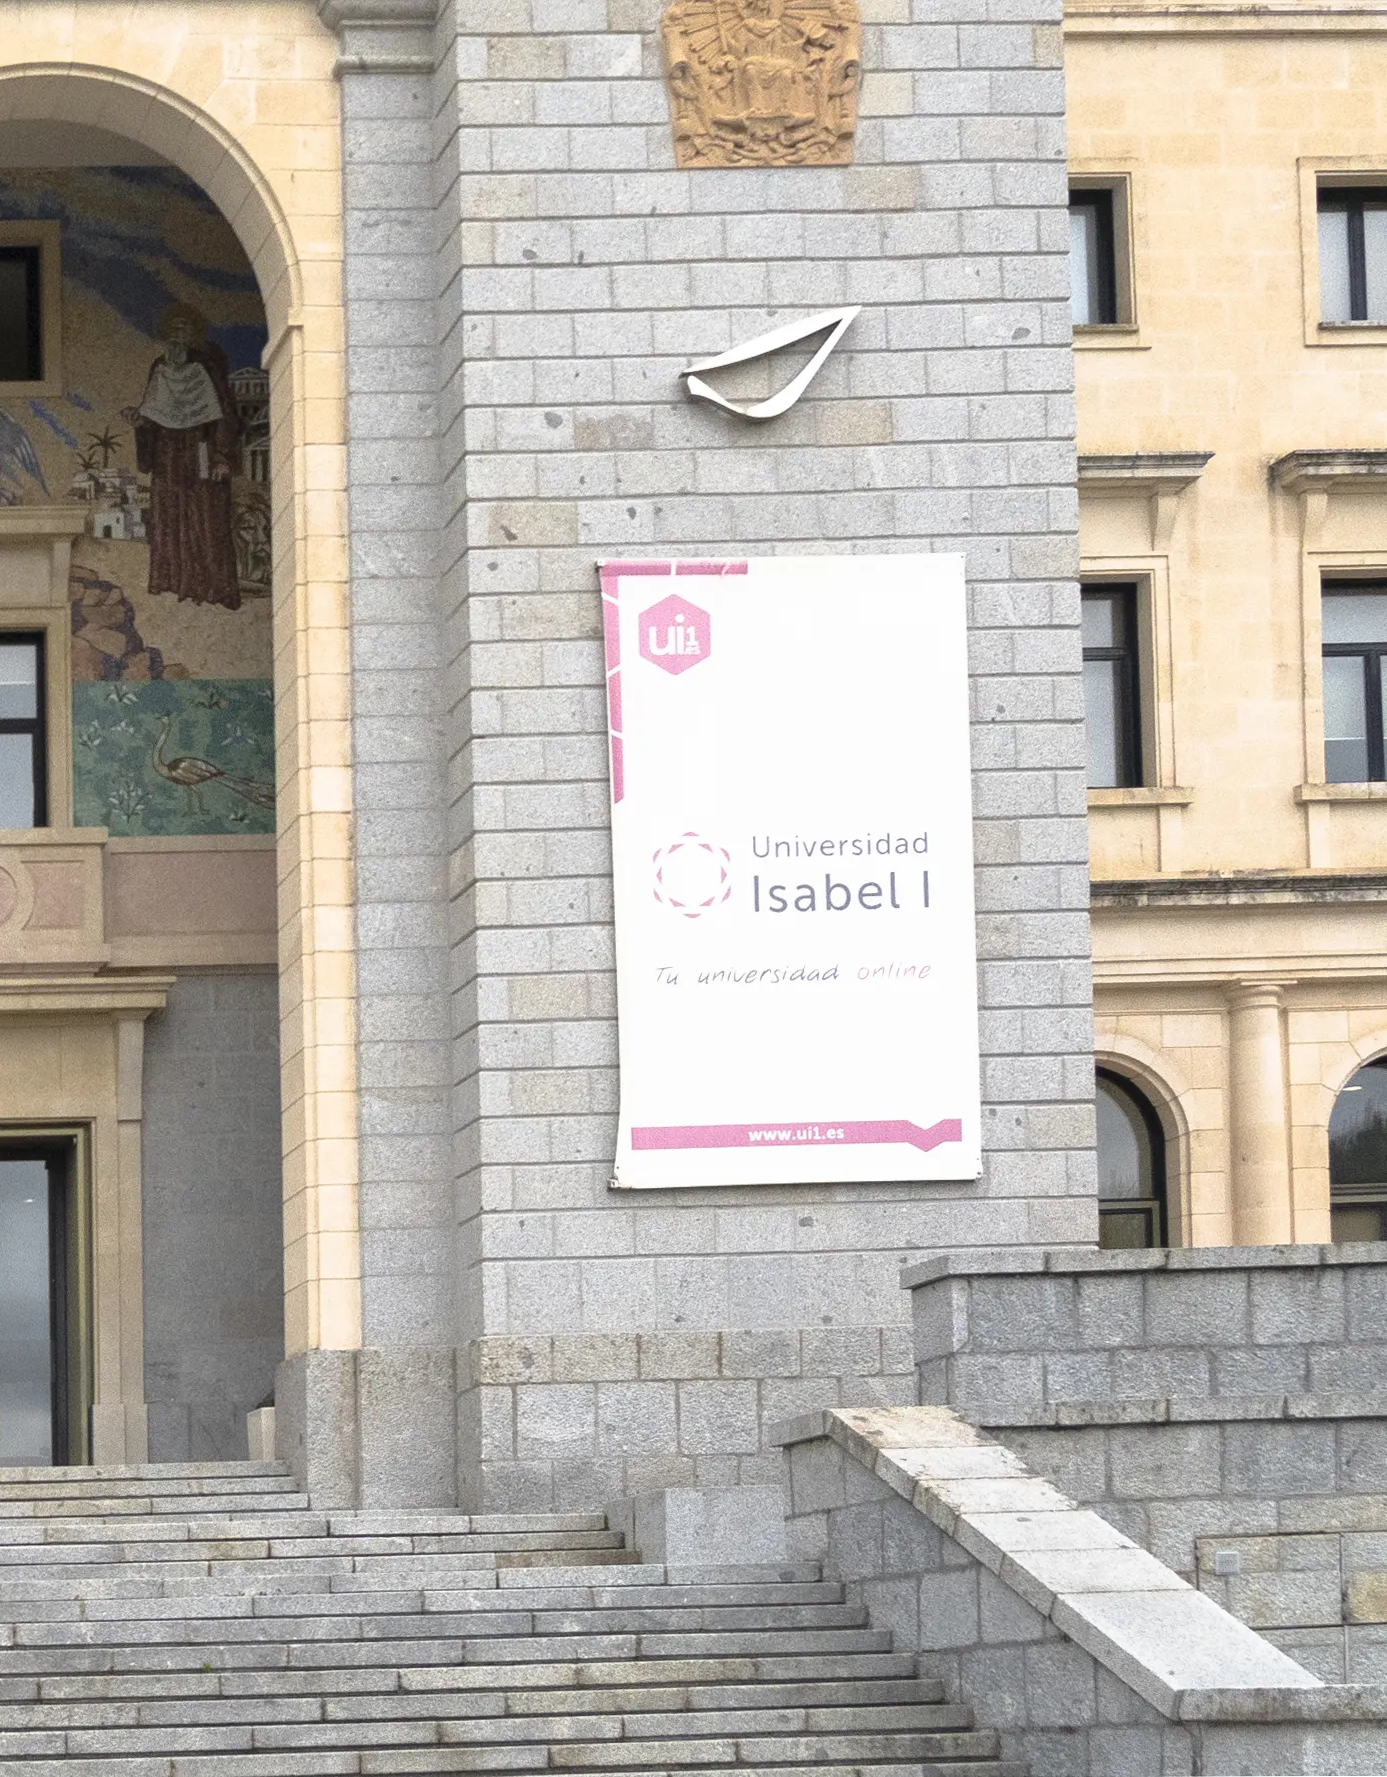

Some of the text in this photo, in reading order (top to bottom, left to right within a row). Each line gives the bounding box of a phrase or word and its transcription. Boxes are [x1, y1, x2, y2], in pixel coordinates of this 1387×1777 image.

[752, 831, 929, 858] Universidad
[753, 870, 930, 913] Isabel I
[655, 962, 932, 986] Tu universidad online
[748, 1126, 845, 1142] www.ui1.es
